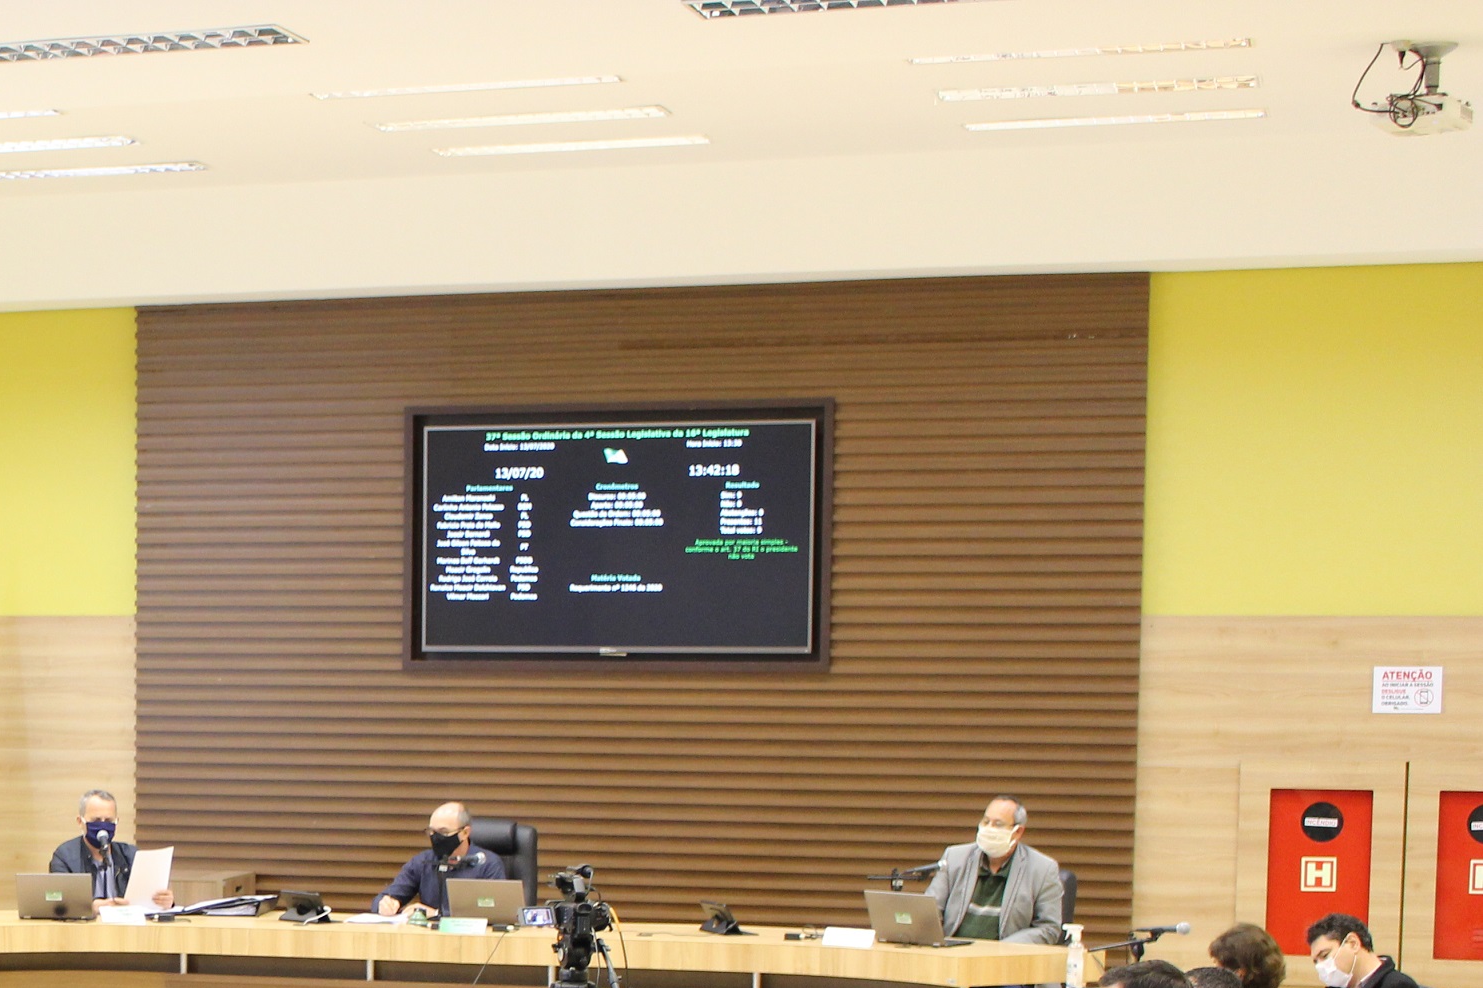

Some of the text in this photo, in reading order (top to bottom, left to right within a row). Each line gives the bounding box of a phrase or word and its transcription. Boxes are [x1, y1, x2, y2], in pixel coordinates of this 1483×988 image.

[502, 432, 531, 441] Sessão
[532, 431, 570, 440] Ordinária
[572, 431, 583, 439] da
[596, 430, 625, 439] Sessão
[627, 429, 671, 439] Legislativa
[703, 428, 750, 439] Legislatura
[495, 467, 544, 480] 13/07/20
[725, 481, 760, 489] Resultado
[1382, 669, 1433, 682] ATENÇÃO
[1306, 862, 1332, 886] H
